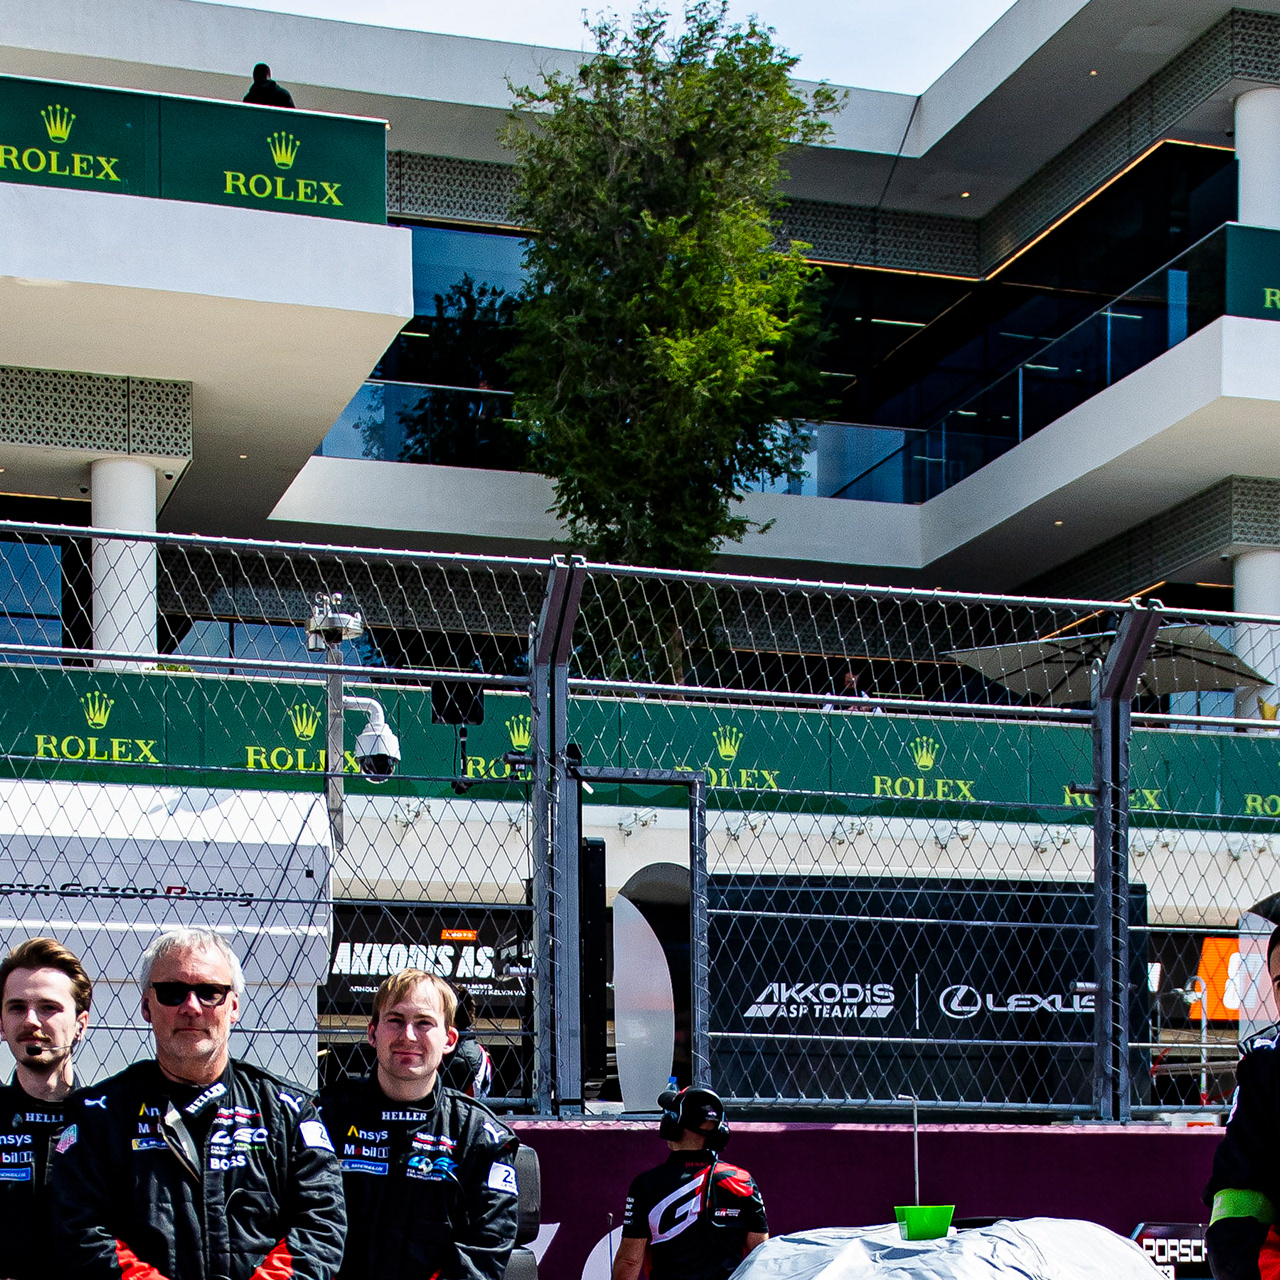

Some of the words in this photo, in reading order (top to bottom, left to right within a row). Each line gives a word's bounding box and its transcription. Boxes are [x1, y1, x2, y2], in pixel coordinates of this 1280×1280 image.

[223, 170, 344, 206] ROLEX
[35, 734, 160, 764] ROLEX
[873, 775, 978, 803] ROLEX
[1062, 784, 1163, 811] ROEX
[456, 946, 496, 978] AS
[777, 1005, 810, 1018] ASP
[815, 1005, 858, 1018] TEAM
[381, 1111, 428, 1121] HELLER
[346, 1125, 389, 1143] Ansys
[343, 1144, 377, 1159] Mobil
